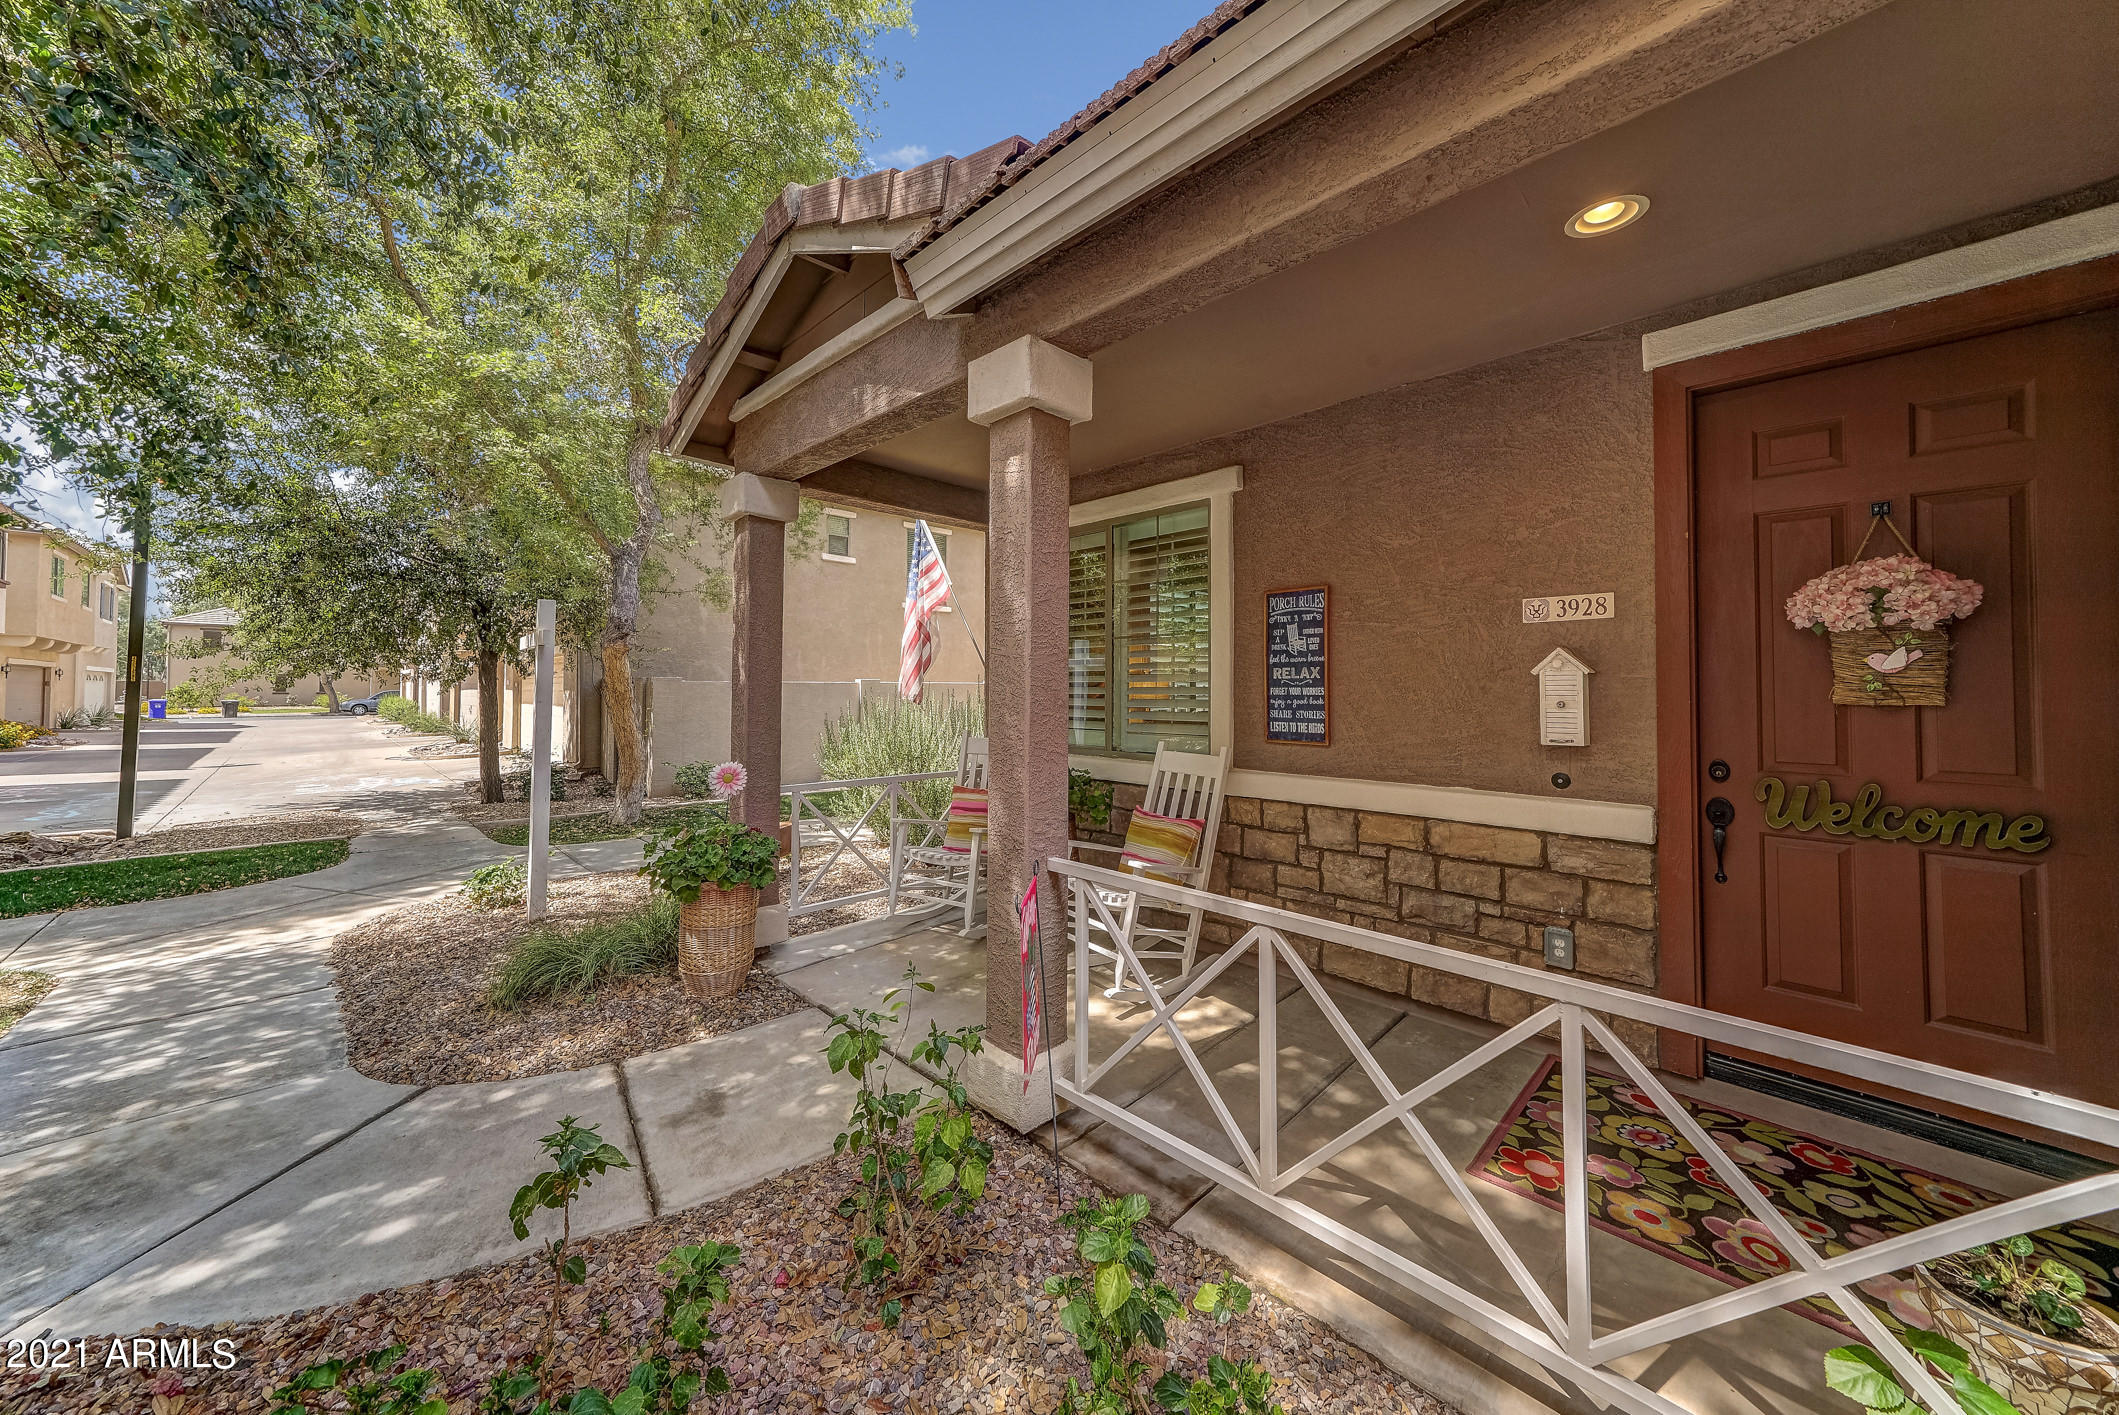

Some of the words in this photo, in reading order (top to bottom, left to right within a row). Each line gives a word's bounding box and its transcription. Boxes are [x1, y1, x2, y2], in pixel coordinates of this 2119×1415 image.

[1269, 597, 1296, 612] PORCH
[1298, 592, 1325, 608] RULES
[1556, 596, 1608, 618] 3928
[1272, 666, 1321, 679] RELAX
[1270, 687, 1288, 696] FORGET
[1289, 687, 1302, 696] YOUR
[1302, 687, 1325, 696] WORRIES
[1292, 697, 1308, 708] good
[1309, 697, 1324, 705] book
[1269, 709, 1293, 718] SHARE
[1295, 710, 1326, 719] STORIES
[1270, 721, 1289, 732] LISTEN
[1289, 722, 1297, 733] TO
[1297, 722, 1308, 733] THE
[1308, 723, 1325, 734] BIRDS
[1755, 777, 2051, 853] Welcome
